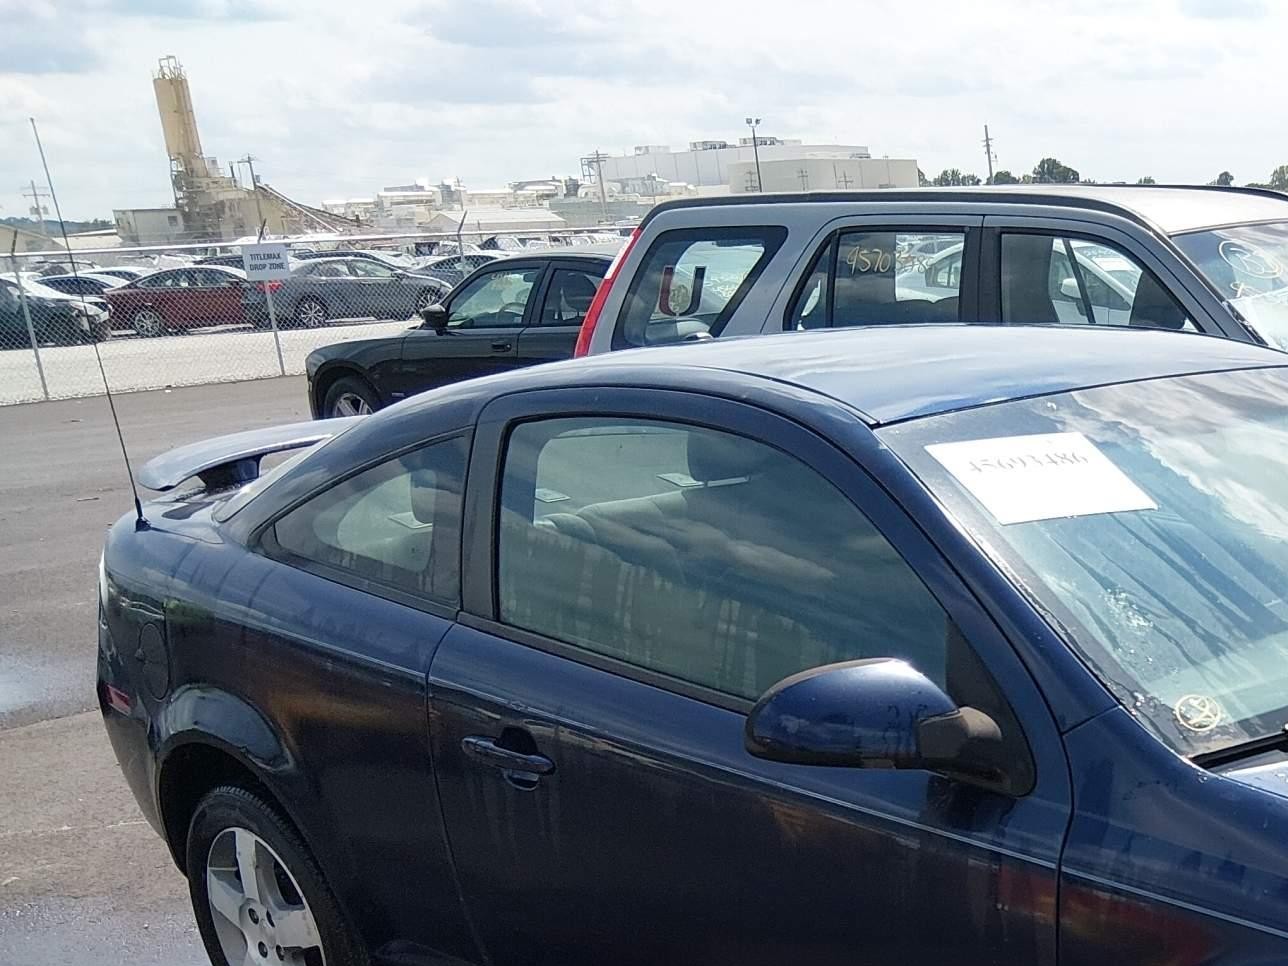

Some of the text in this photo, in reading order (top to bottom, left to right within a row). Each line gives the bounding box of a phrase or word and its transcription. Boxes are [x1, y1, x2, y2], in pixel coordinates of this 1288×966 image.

[250, 252, 281, 260] TITLEMAX
[250, 262, 286, 271] DROP ZONE
